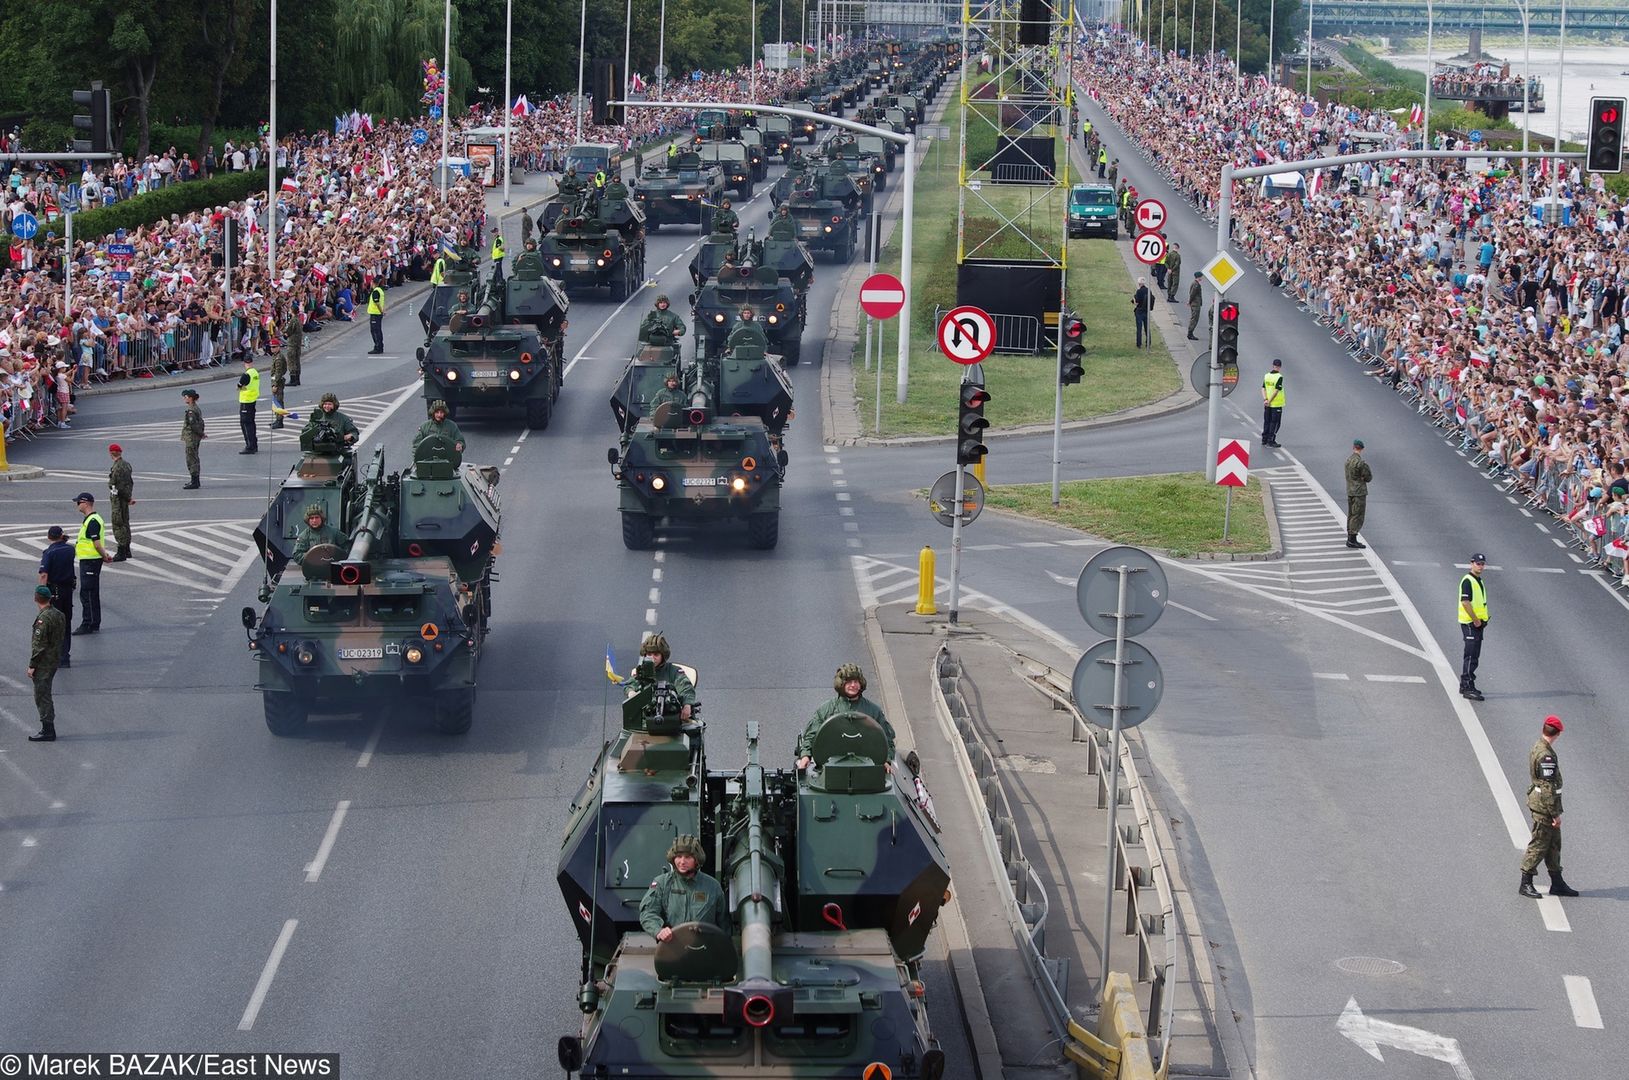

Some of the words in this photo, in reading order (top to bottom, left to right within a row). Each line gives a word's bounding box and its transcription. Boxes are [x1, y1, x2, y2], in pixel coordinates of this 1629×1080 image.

[1141, 240, 1161, 256] 70
[343, 649, 355, 658] UC
[356, 649, 382, 658] 02319
[1543, 768, 1554, 777] MP
